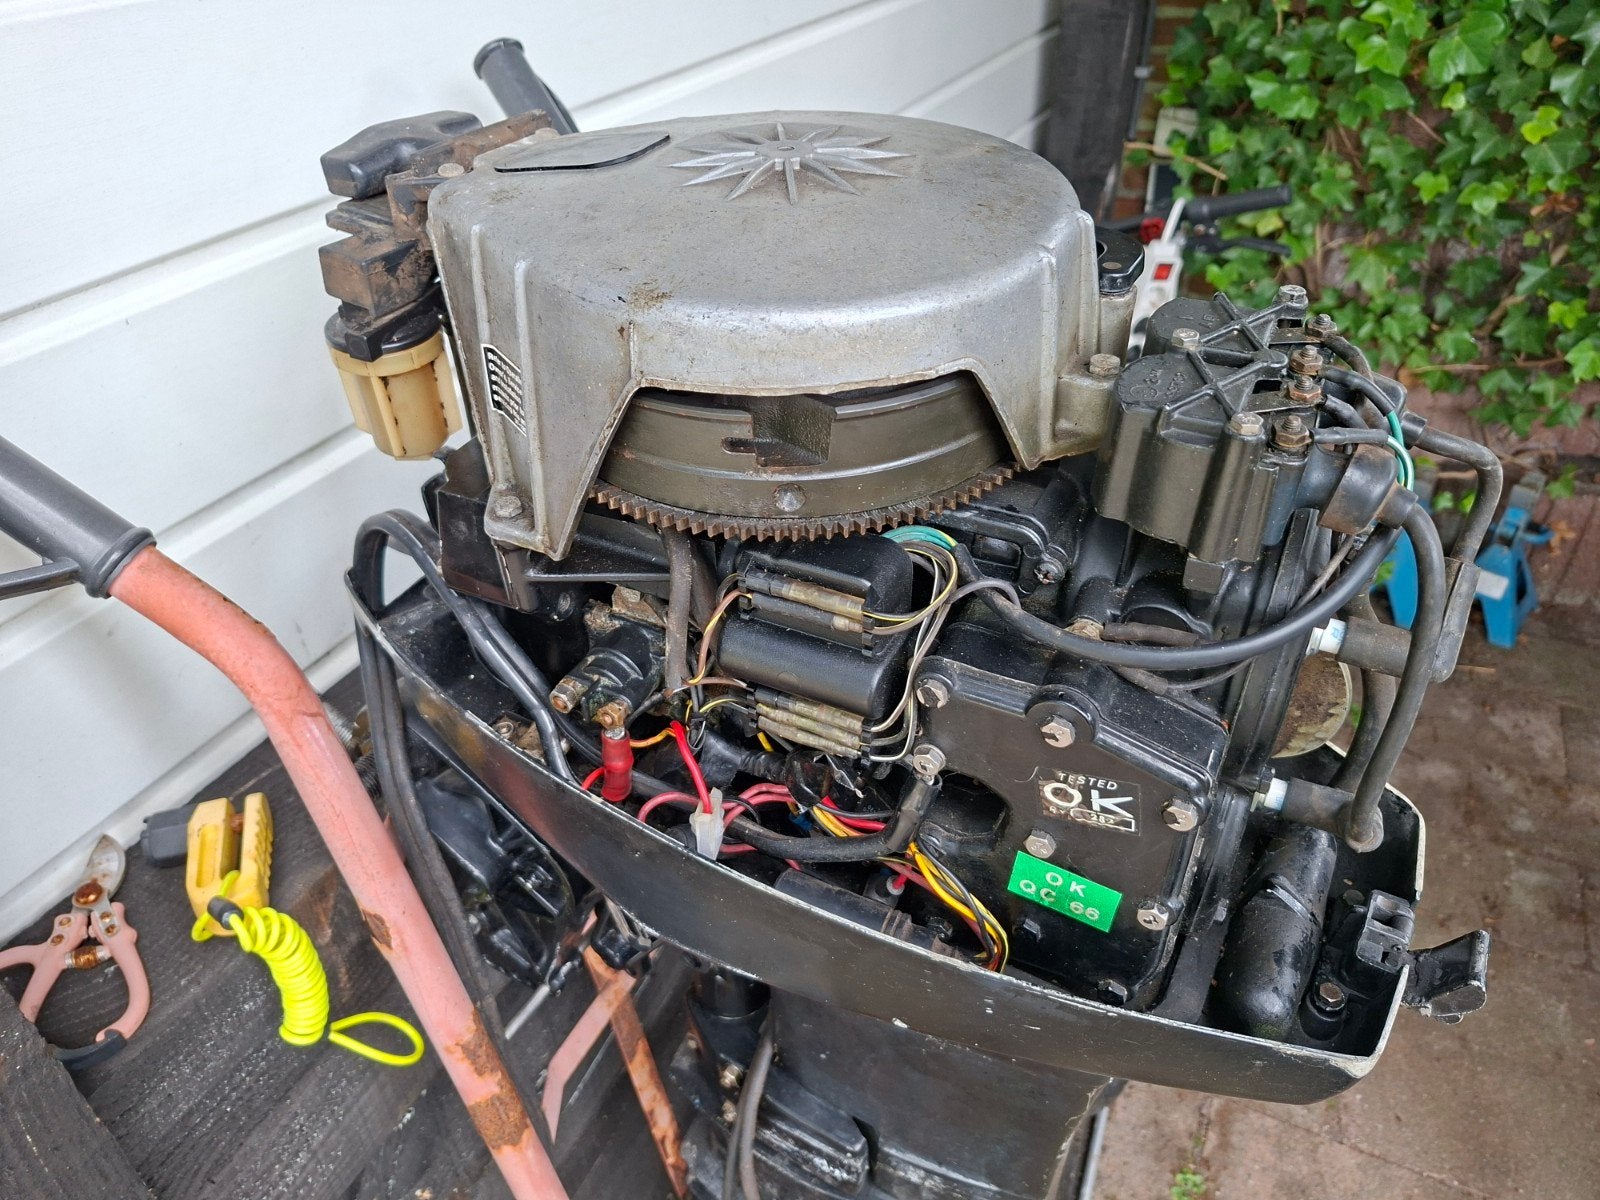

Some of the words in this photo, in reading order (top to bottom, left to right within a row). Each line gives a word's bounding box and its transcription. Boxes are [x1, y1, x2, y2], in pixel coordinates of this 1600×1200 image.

[1058, 772, 1118, 790] TESTED
[1043, 782, 1134, 818] OK
[1019, 879, 1056, 902] QC
[1069, 901, 1100, 921] 66
[1045, 872, 1087, 898] OK
